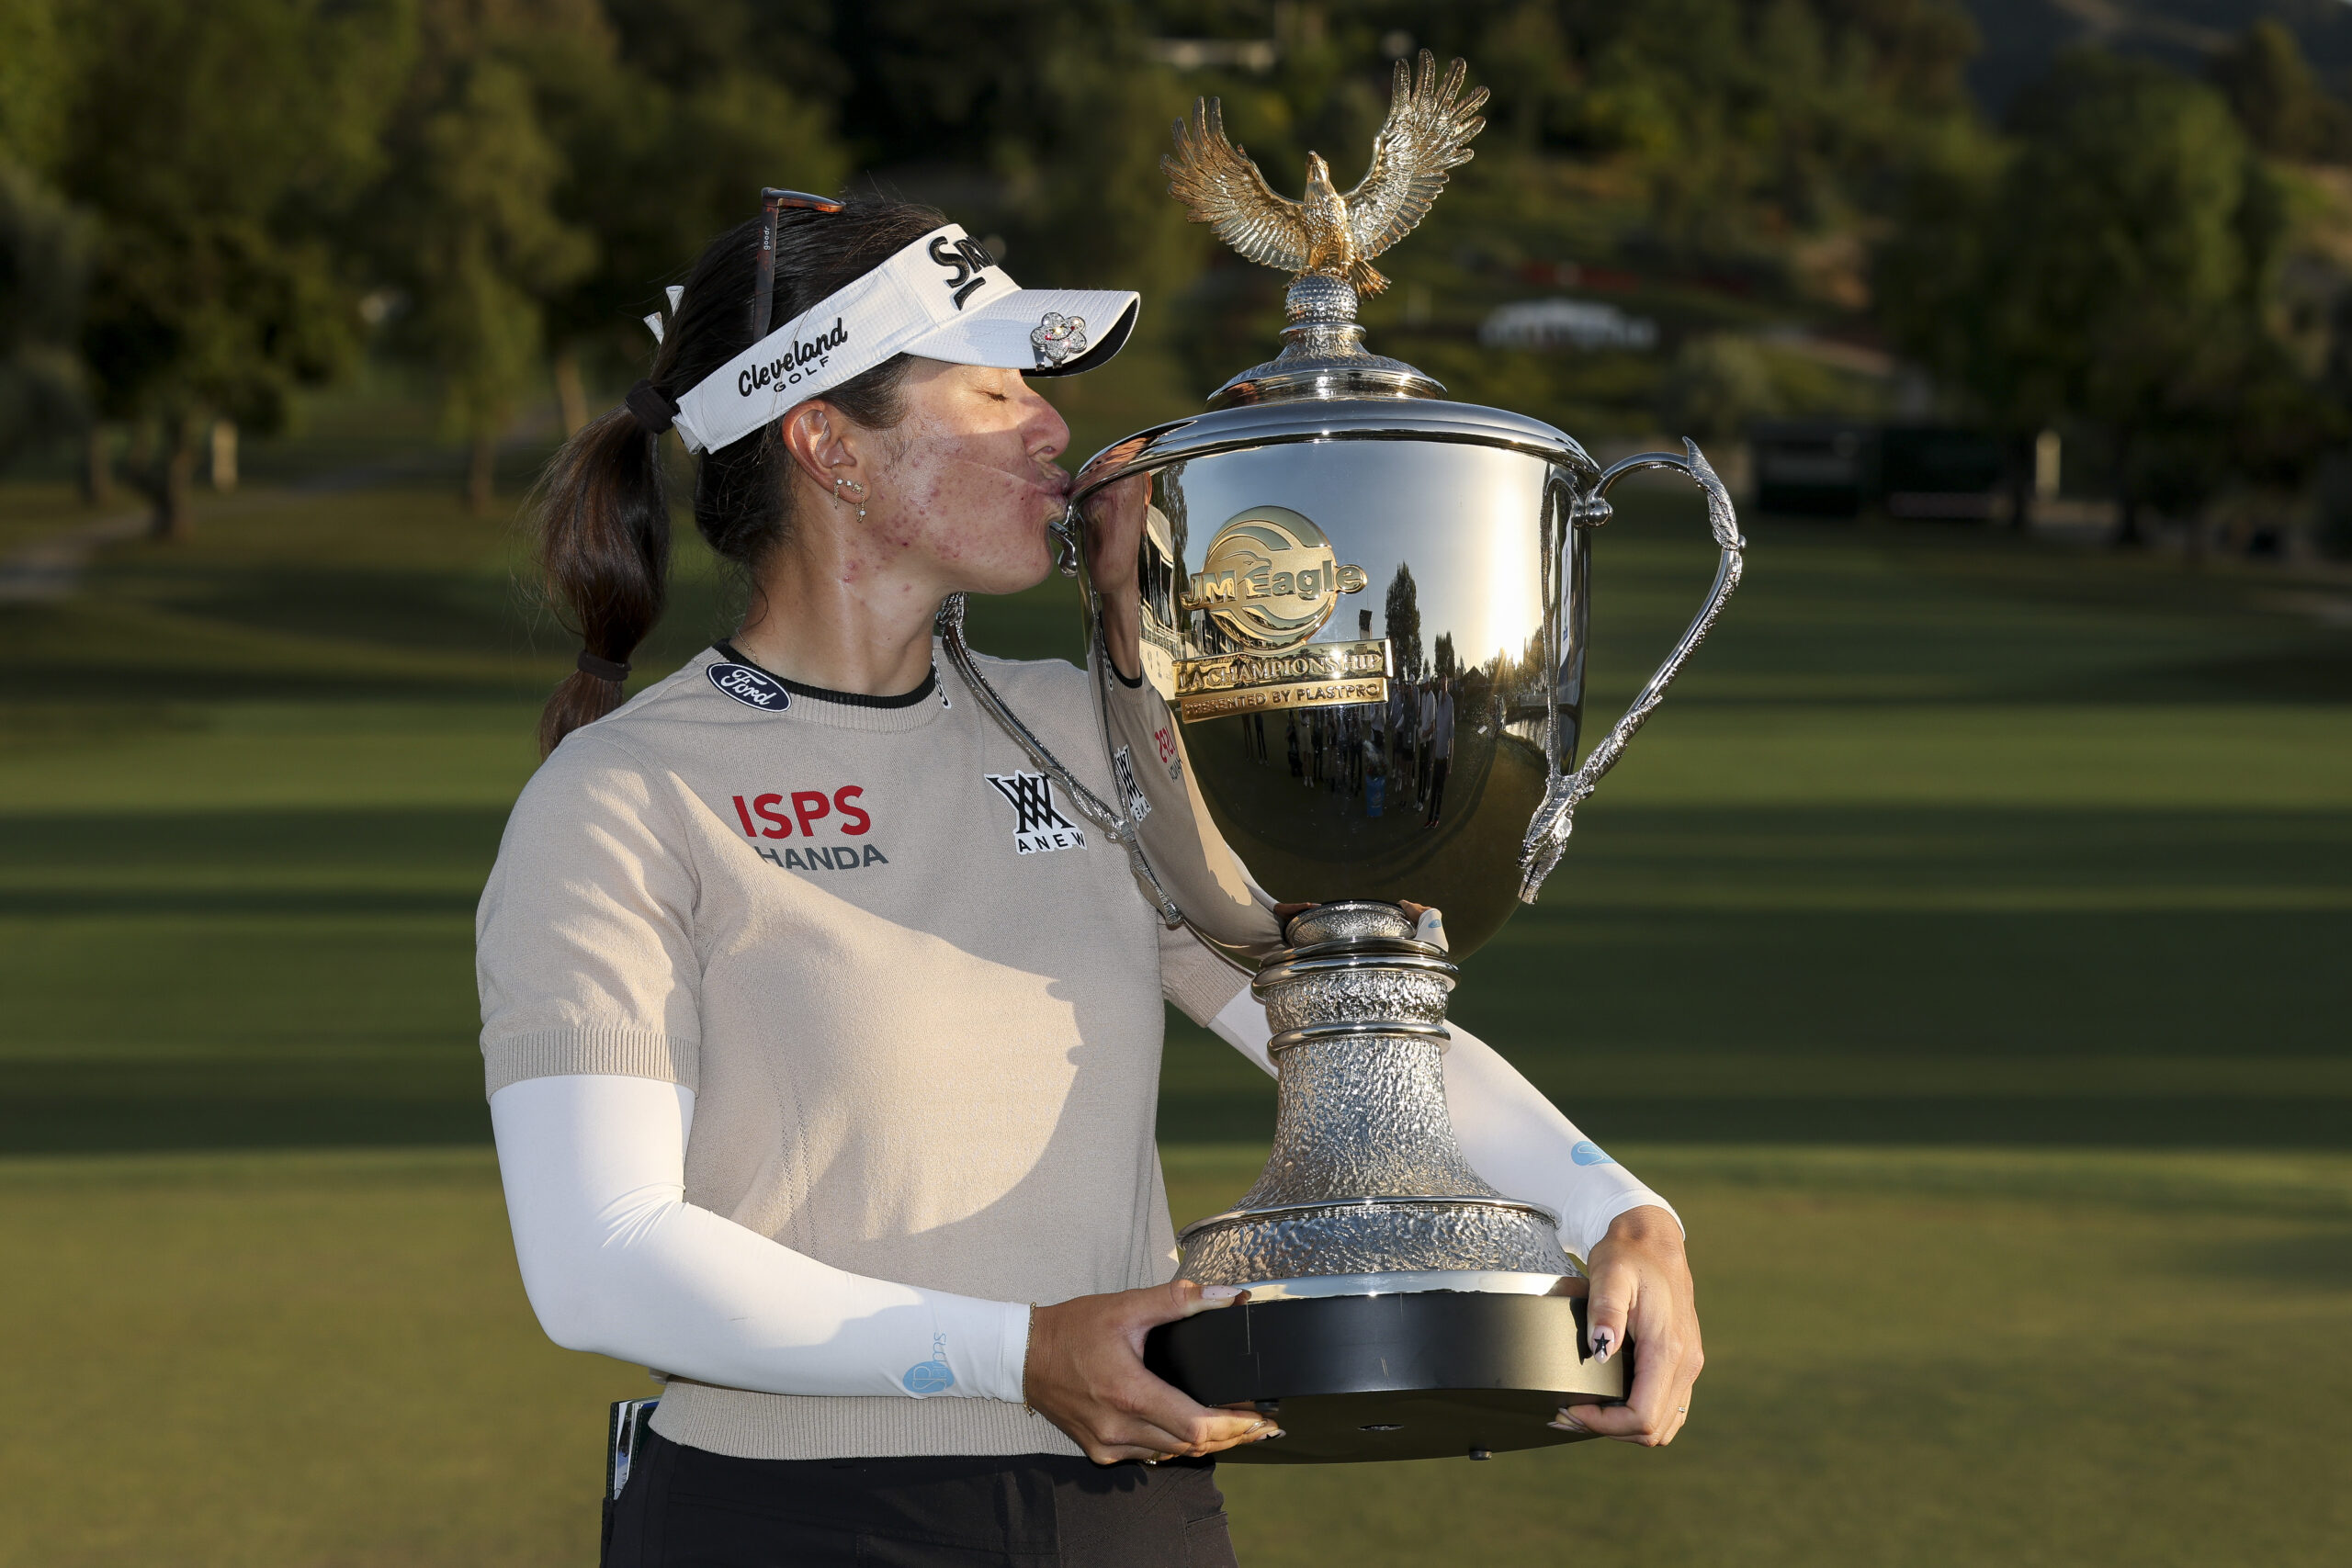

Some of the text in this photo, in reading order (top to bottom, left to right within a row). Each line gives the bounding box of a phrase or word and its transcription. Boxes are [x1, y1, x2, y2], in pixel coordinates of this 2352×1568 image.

[763, 226, 772, 251] goodr
[739, 317, 848, 398] Cleveland
[774, 355, 829, 392] GOLF
[1182, 559, 1363, 607] JM Eagle
[1208, 653, 1383, 685] CHAMPIONSHIP
[721, 669, 777, 705] Ford
[1185, 683, 1378, 714] PRESENTED BY PLASTPRO
[732, 784, 871, 840] ISPS
[753, 843, 889, 871] HANDA
[1018, 832, 1085, 852] ANEW
